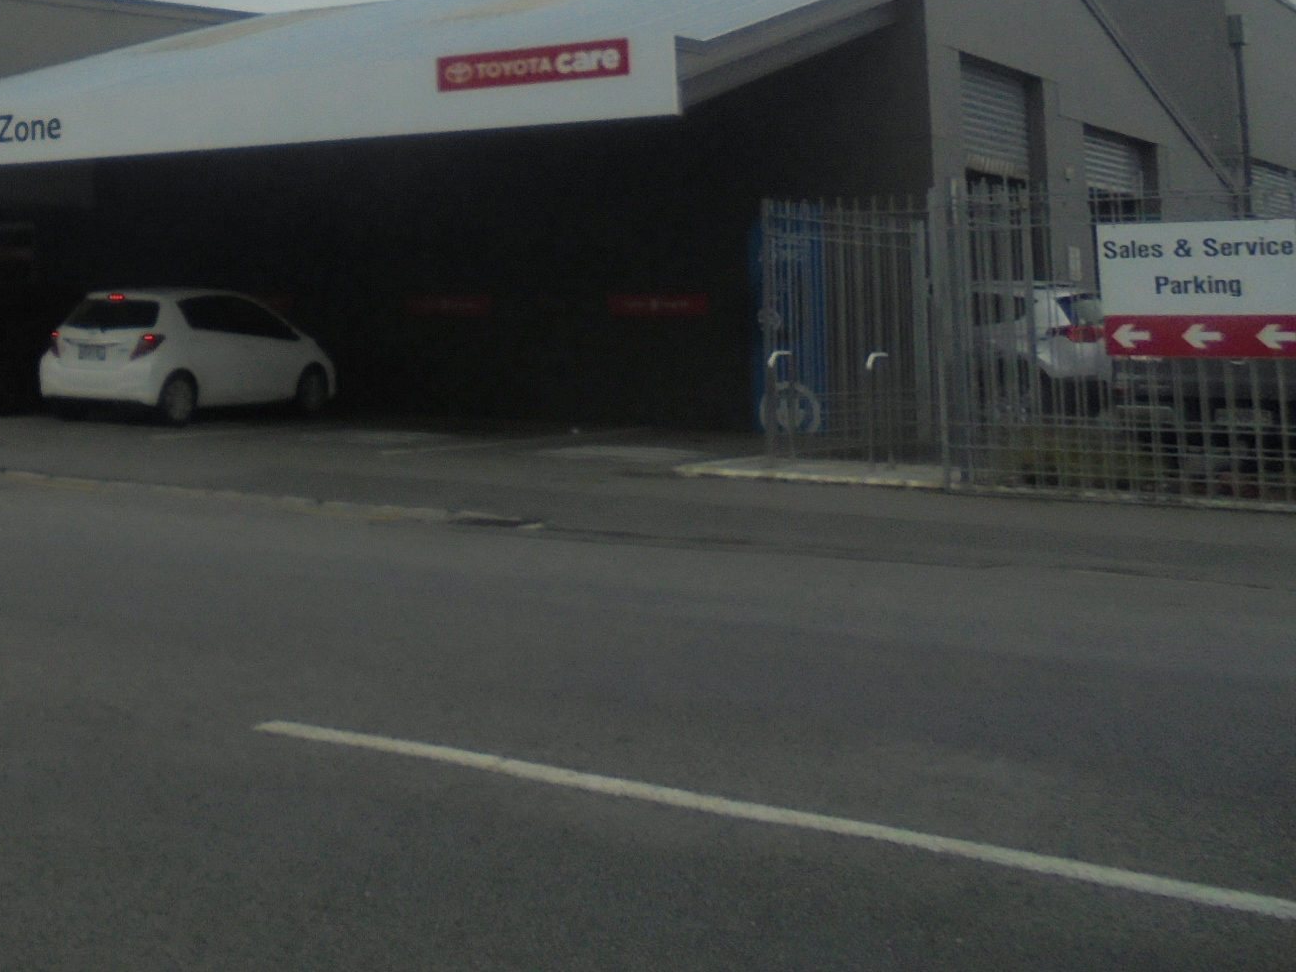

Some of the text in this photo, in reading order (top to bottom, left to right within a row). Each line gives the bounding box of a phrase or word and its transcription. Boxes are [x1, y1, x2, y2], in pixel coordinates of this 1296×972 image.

[476, 48, 621, 79] TOYOTA care
[1103, 236, 1295, 259] Sales & Service
[1154, 275, 1243, 298] Parking
